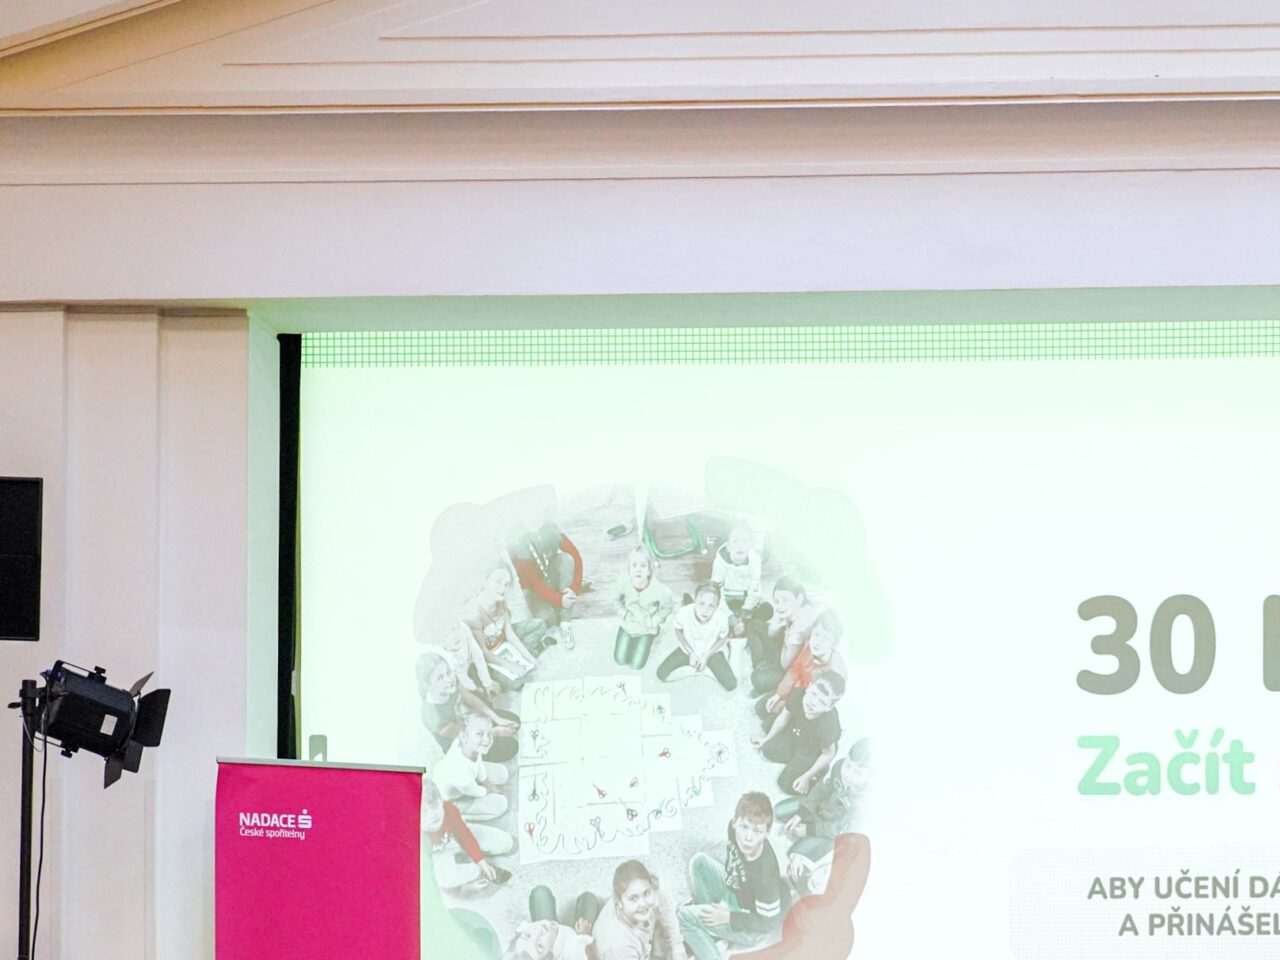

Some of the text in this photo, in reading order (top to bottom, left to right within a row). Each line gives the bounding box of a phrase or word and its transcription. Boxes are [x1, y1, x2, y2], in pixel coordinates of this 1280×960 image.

[1075, 593, 1217, 695] 30
[1077, 727, 1256, 796] Začít
[239, 812, 296, 828] NADACE
[239, 826, 305, 840] České spořitelny
[1087, 876, 1145, 900] ABY
[1154, 868, 1240, 899] UČENÍ
[1118, 912, 1140, 936] A
